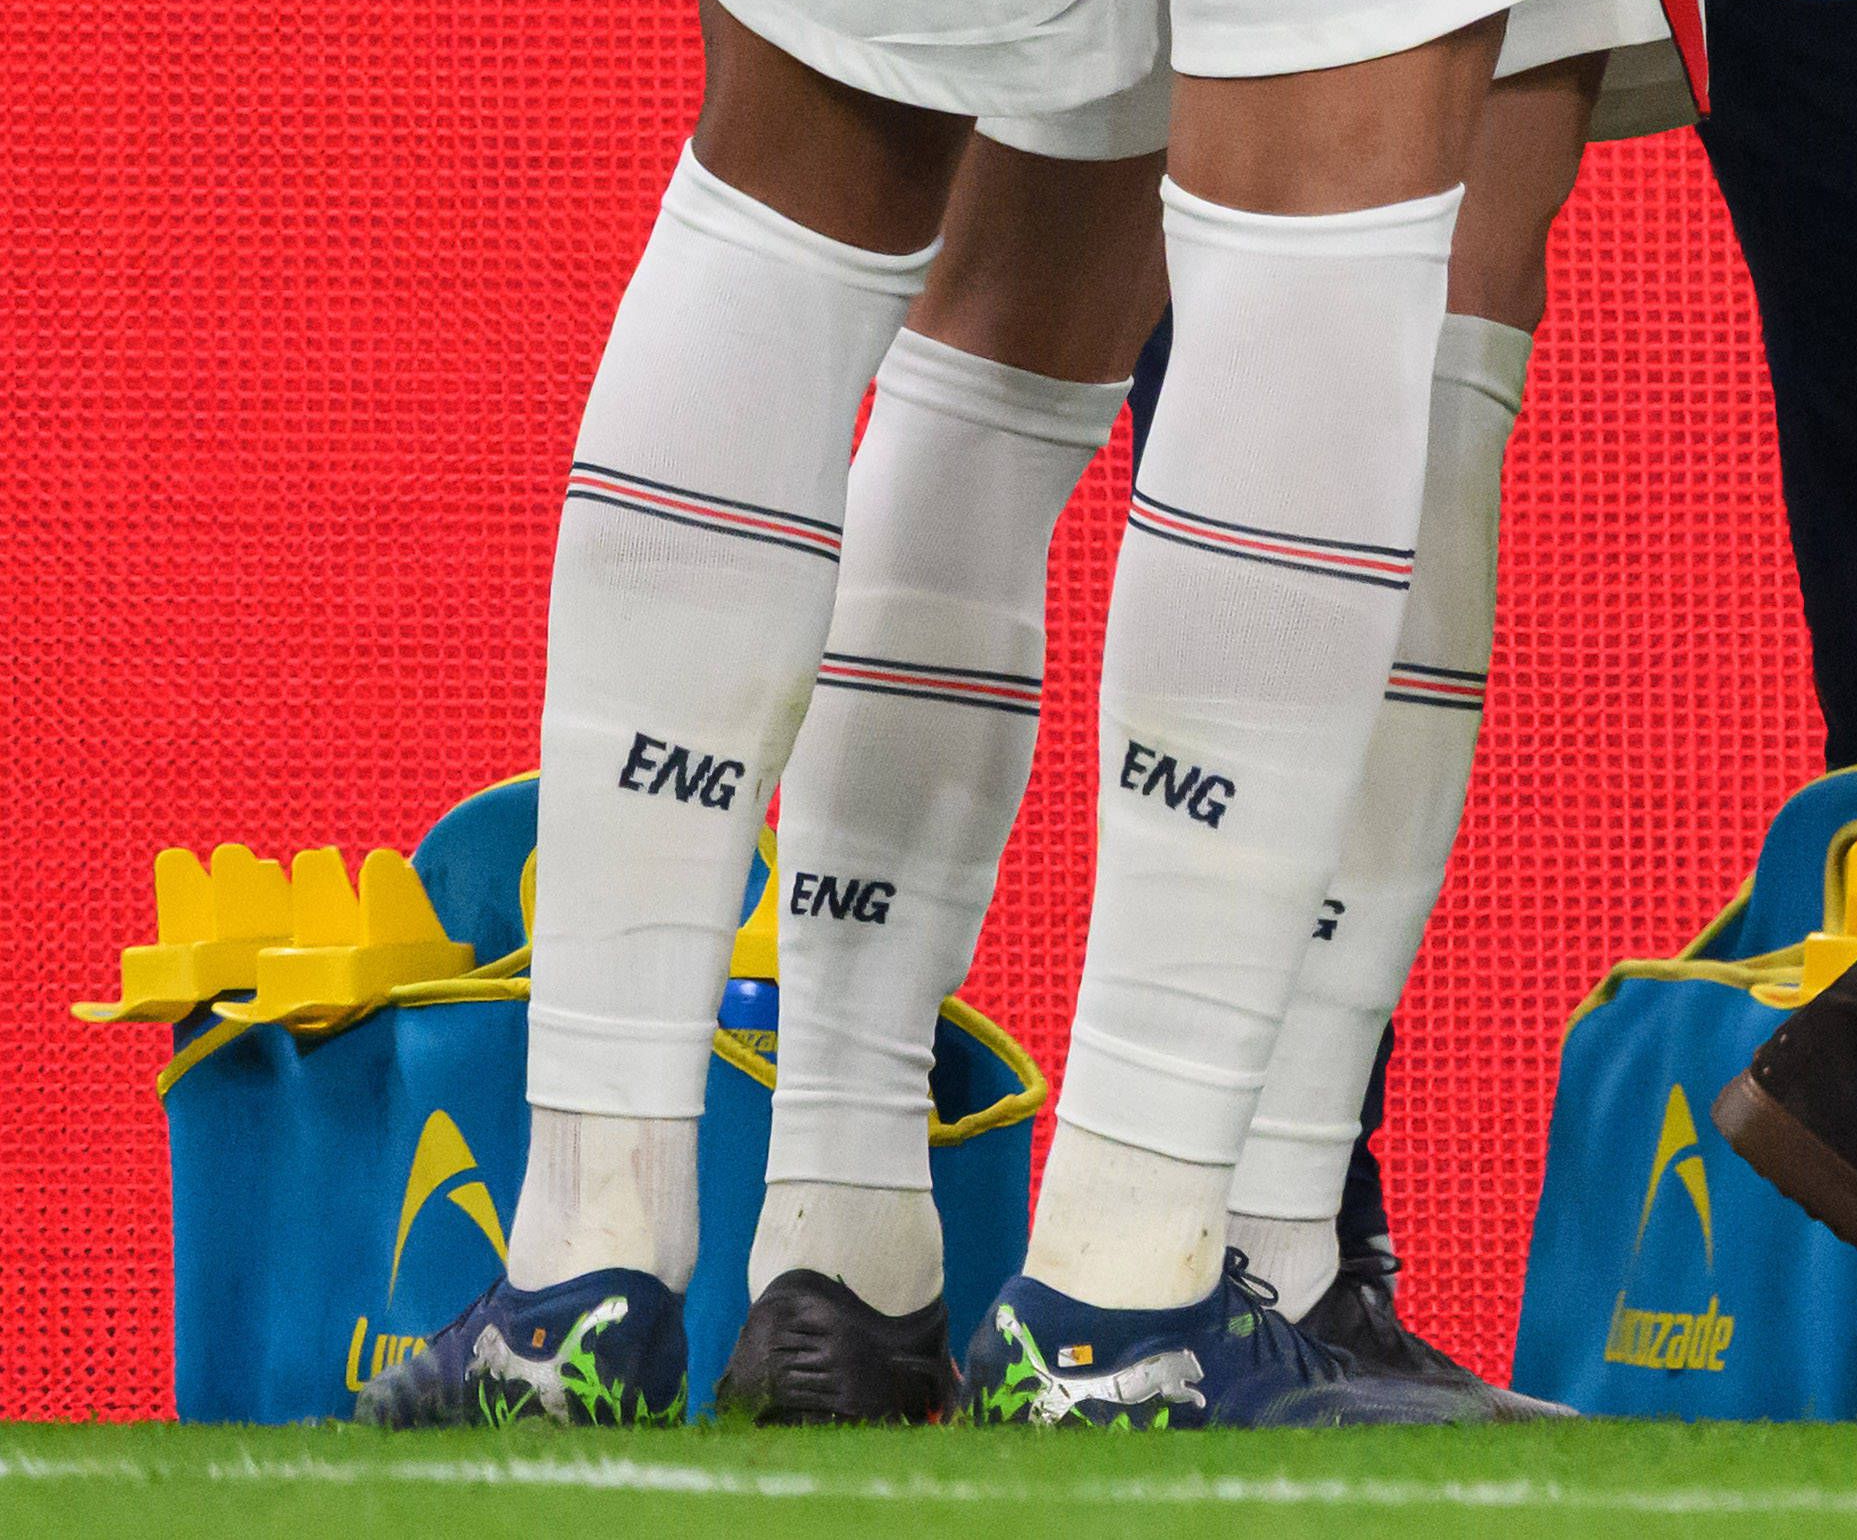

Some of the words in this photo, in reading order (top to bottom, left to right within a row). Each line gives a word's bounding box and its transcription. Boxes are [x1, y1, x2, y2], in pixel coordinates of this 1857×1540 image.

[619, 732, 746, 812] ENG
[1121, 740, 1235, 828] ENG
[791, 872, 897, 924] ENG
